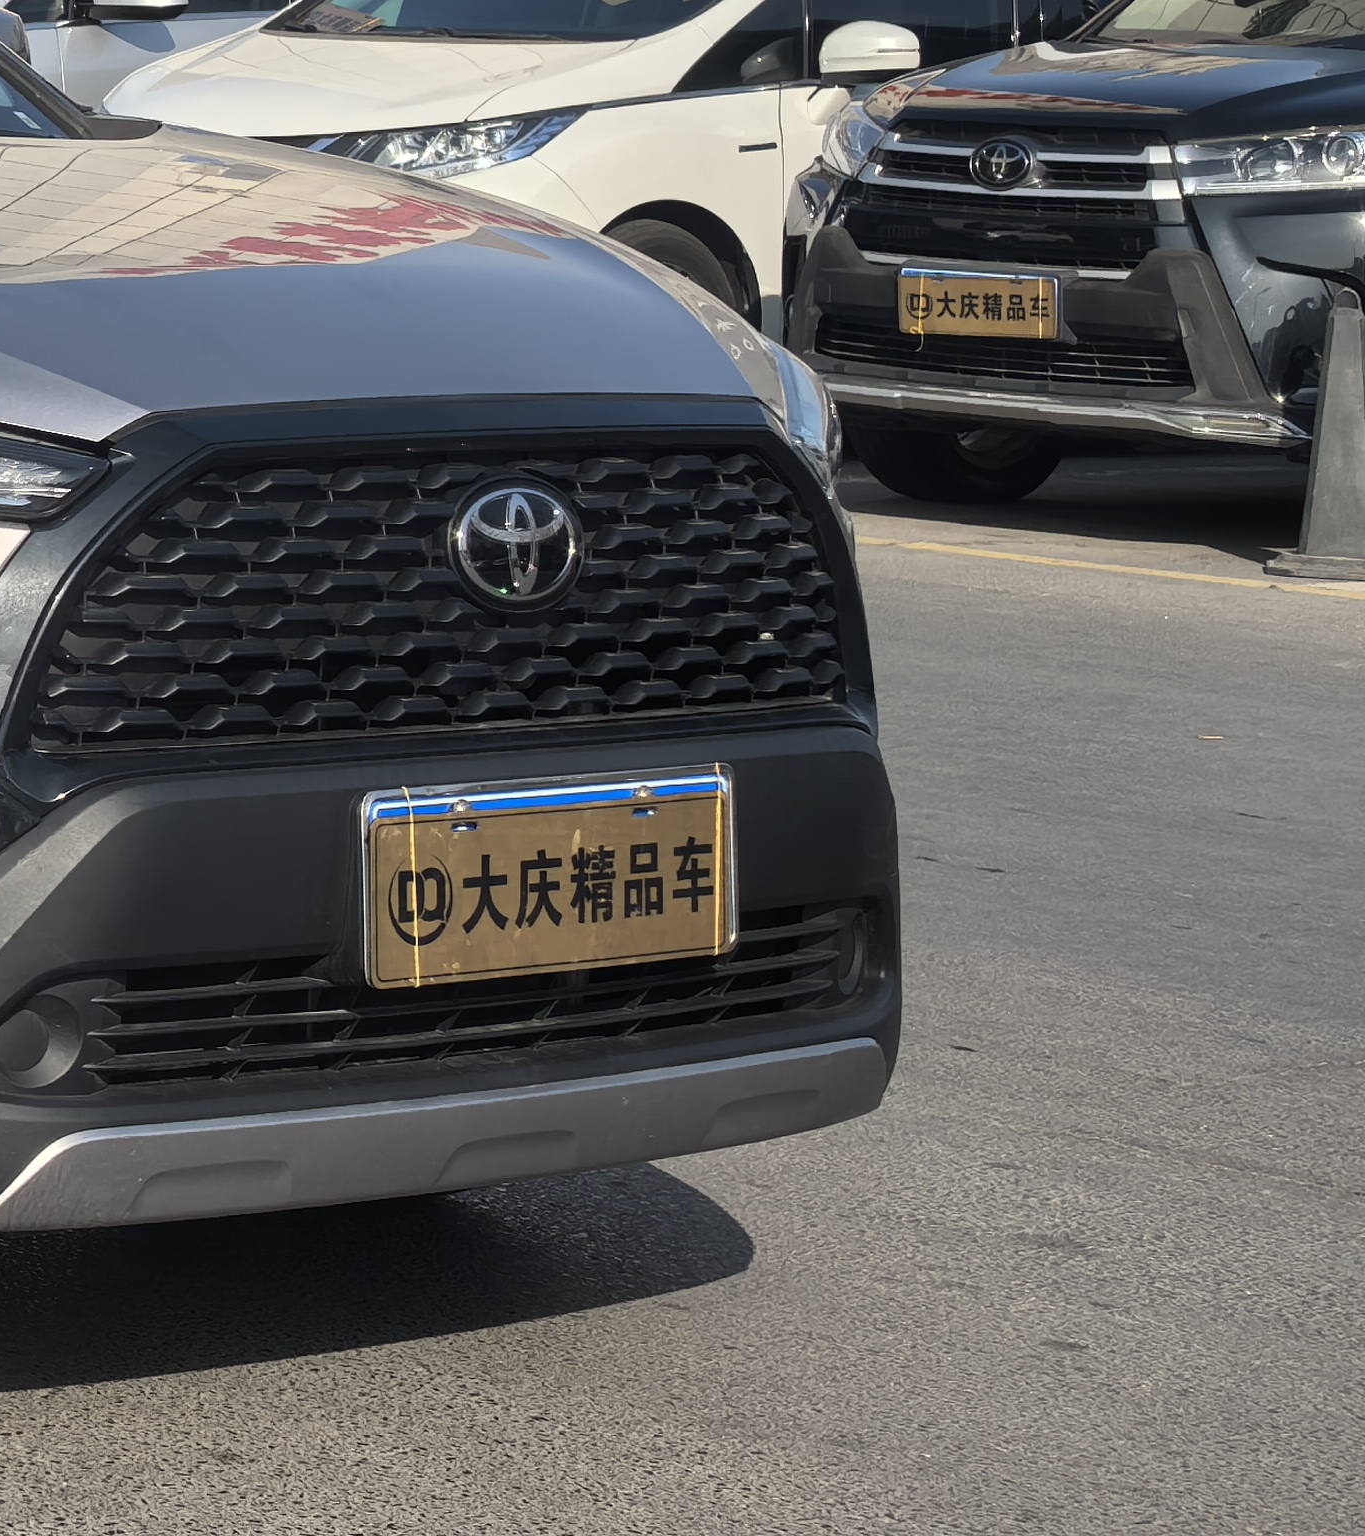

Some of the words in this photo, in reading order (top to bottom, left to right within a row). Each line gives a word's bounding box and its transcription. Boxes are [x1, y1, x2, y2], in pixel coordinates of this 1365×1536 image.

[936, 290, 1050, 322] 大庆精品车
[462, 836, 715, 935] 大庆精品车
